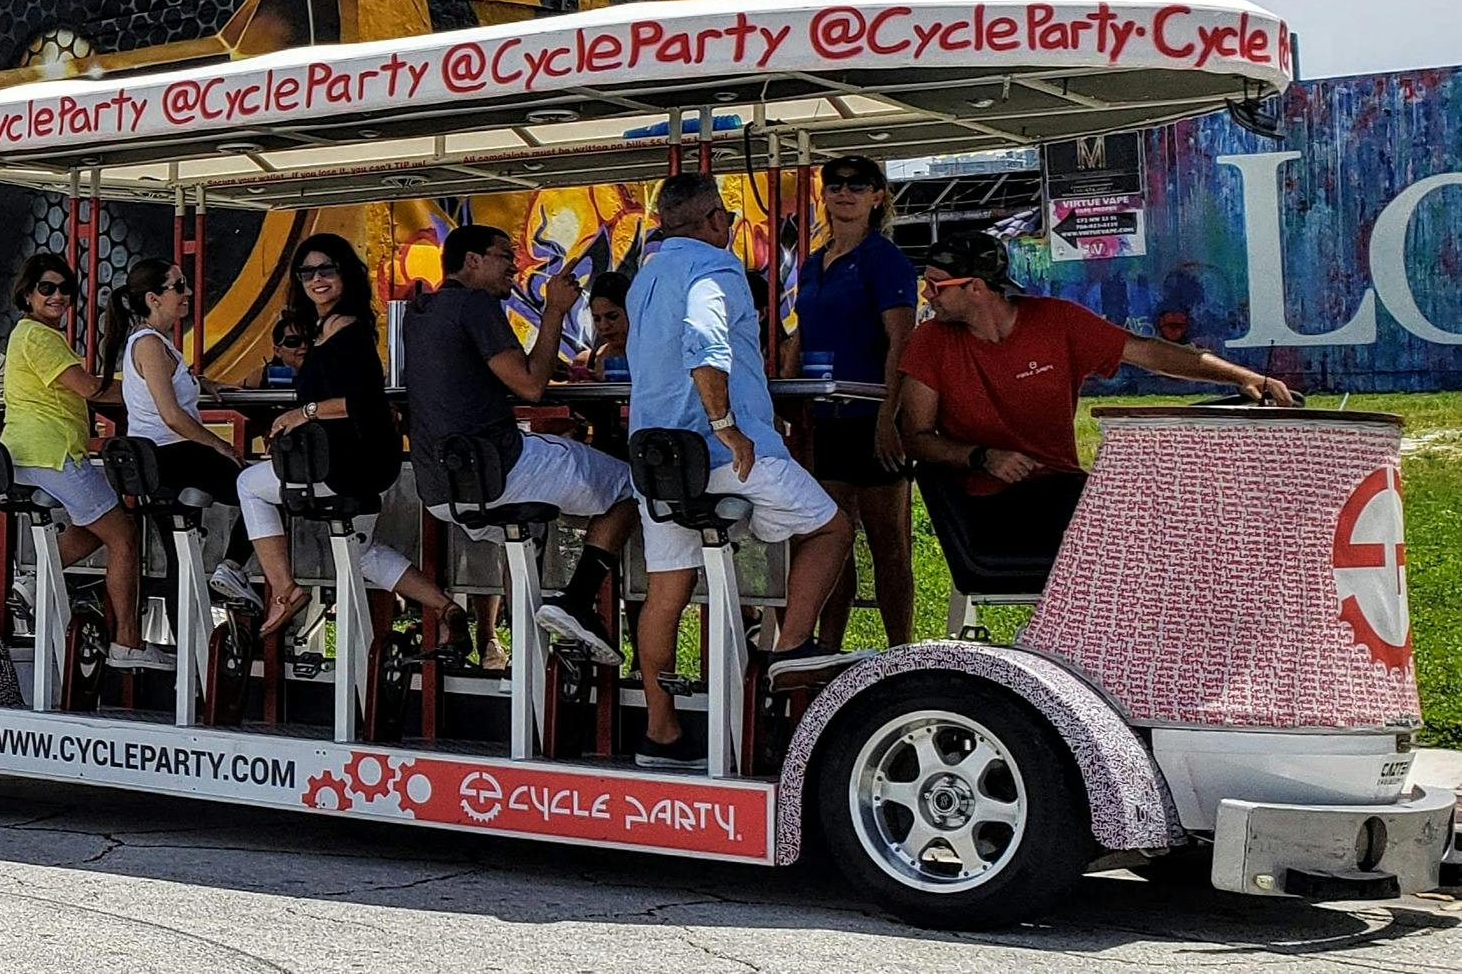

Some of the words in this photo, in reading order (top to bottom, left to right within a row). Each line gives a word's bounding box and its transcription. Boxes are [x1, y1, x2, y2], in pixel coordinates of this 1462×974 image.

[162, 52, 429, 125] @CycleParty
[441, 12, 791, 94] @CycleParty
[1153, 4, 1272, 68] Cycle
[1062, 198, 1101, 208] VIRTUE
[1102, 196, 1130, 205] VAPE
[508, 785, 612, 821] CYCLE
